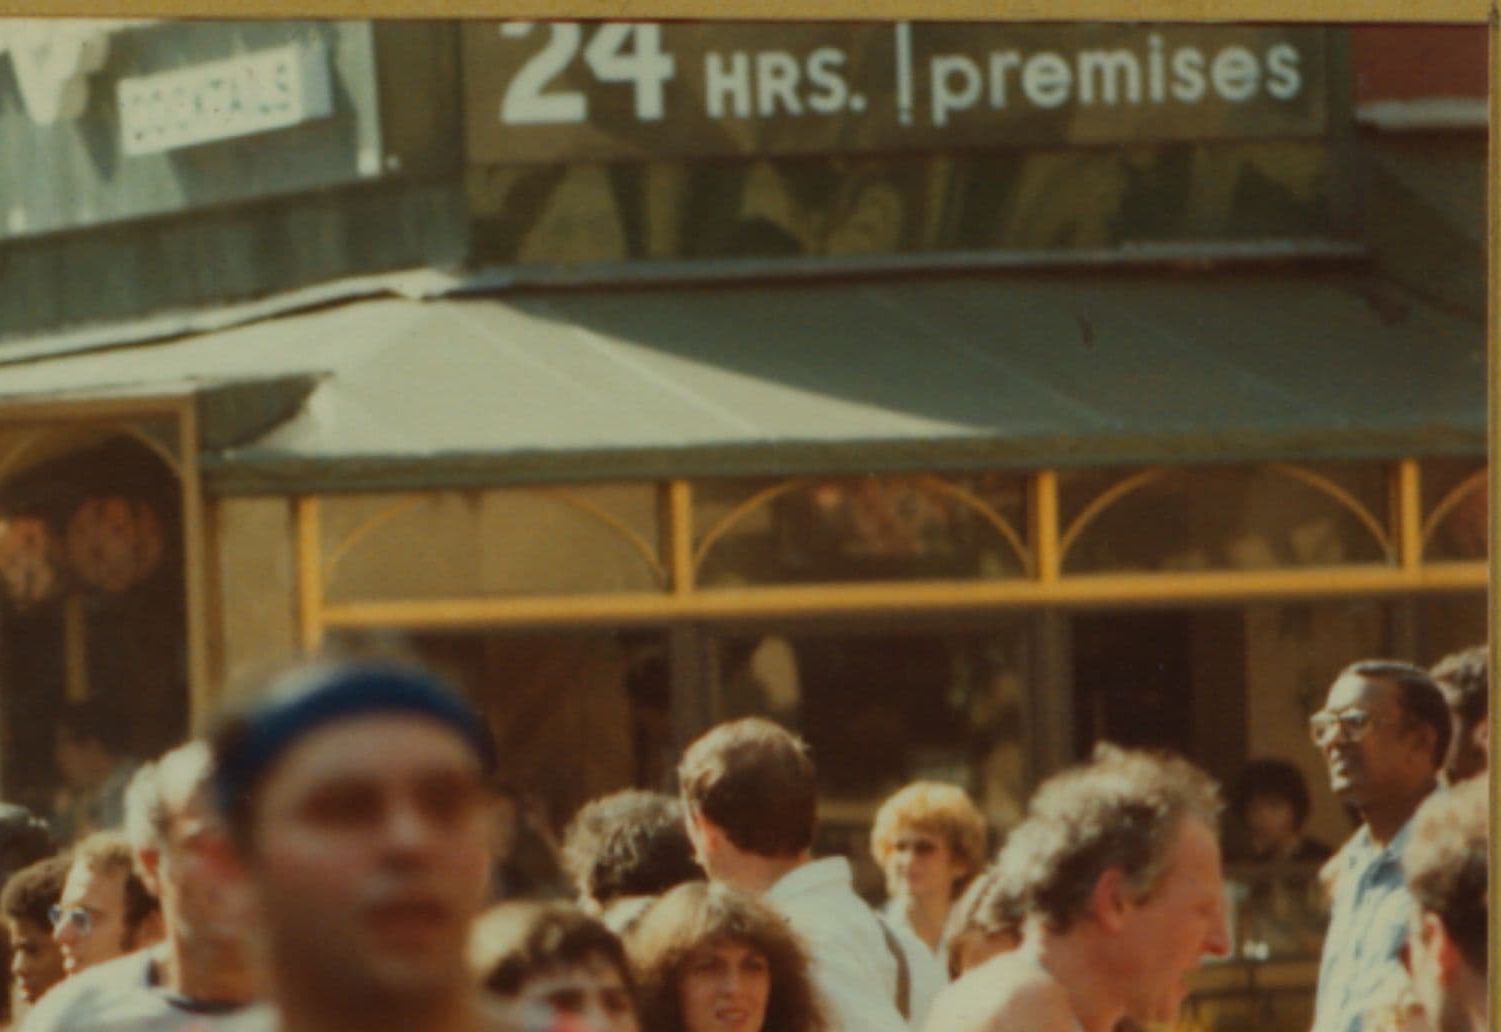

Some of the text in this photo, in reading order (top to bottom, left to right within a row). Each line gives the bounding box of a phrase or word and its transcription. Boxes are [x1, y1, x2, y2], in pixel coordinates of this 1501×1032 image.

[500, 22, 870, 124] 24 HRS.
[930, 34, 1302, 127] premises
